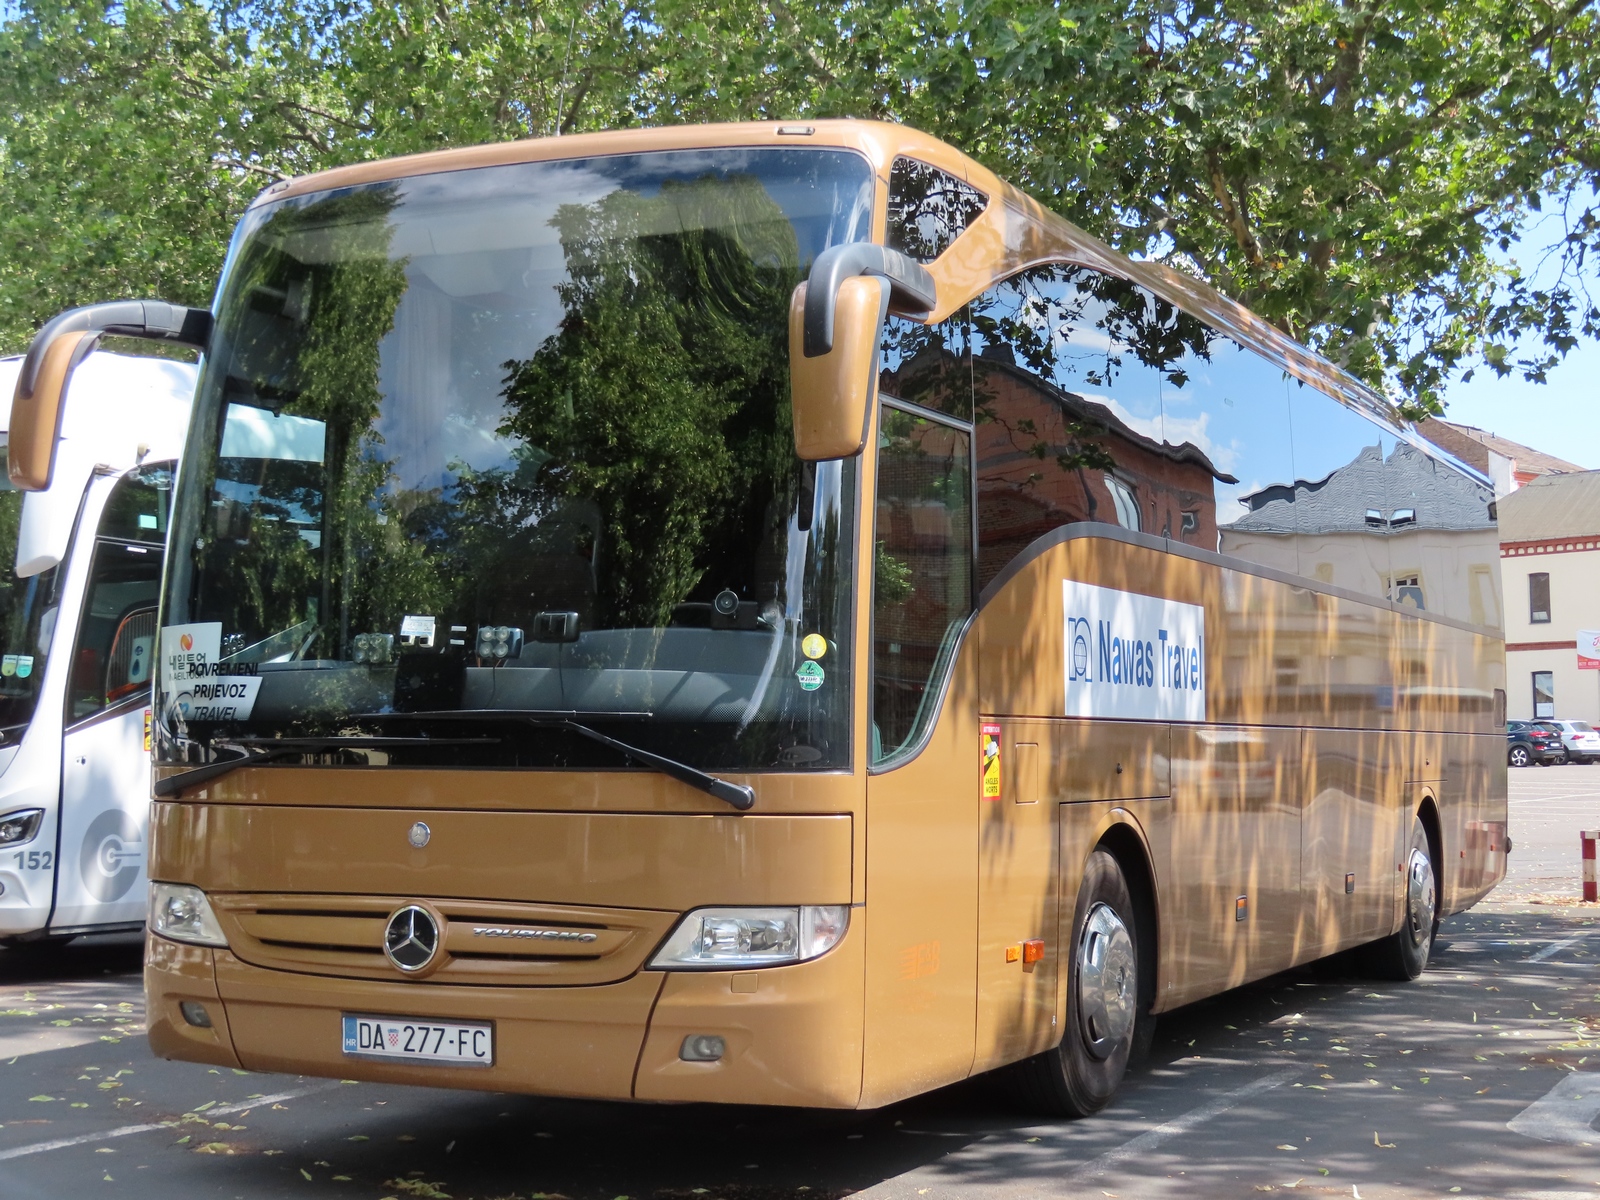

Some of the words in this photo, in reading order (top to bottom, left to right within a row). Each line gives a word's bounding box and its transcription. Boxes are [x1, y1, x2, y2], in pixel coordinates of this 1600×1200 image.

[169, 652, 206, 670] 내일투어
[1098, 619, 1154, 688] Nawas
[1158, 629, 1203, 692] Travel
[189, 662, 258, 676] POVREMENI
[193, 684, 246, 700] PRIJEVOZ
[194, 707, 238, 721] TRAVEL
[13, 851, 52, 870] 152
[473, 927, 597, 944] TOURISMO
[345, 1038, 357, 1047] HR
[359, 1022, 385, 1050] DA
